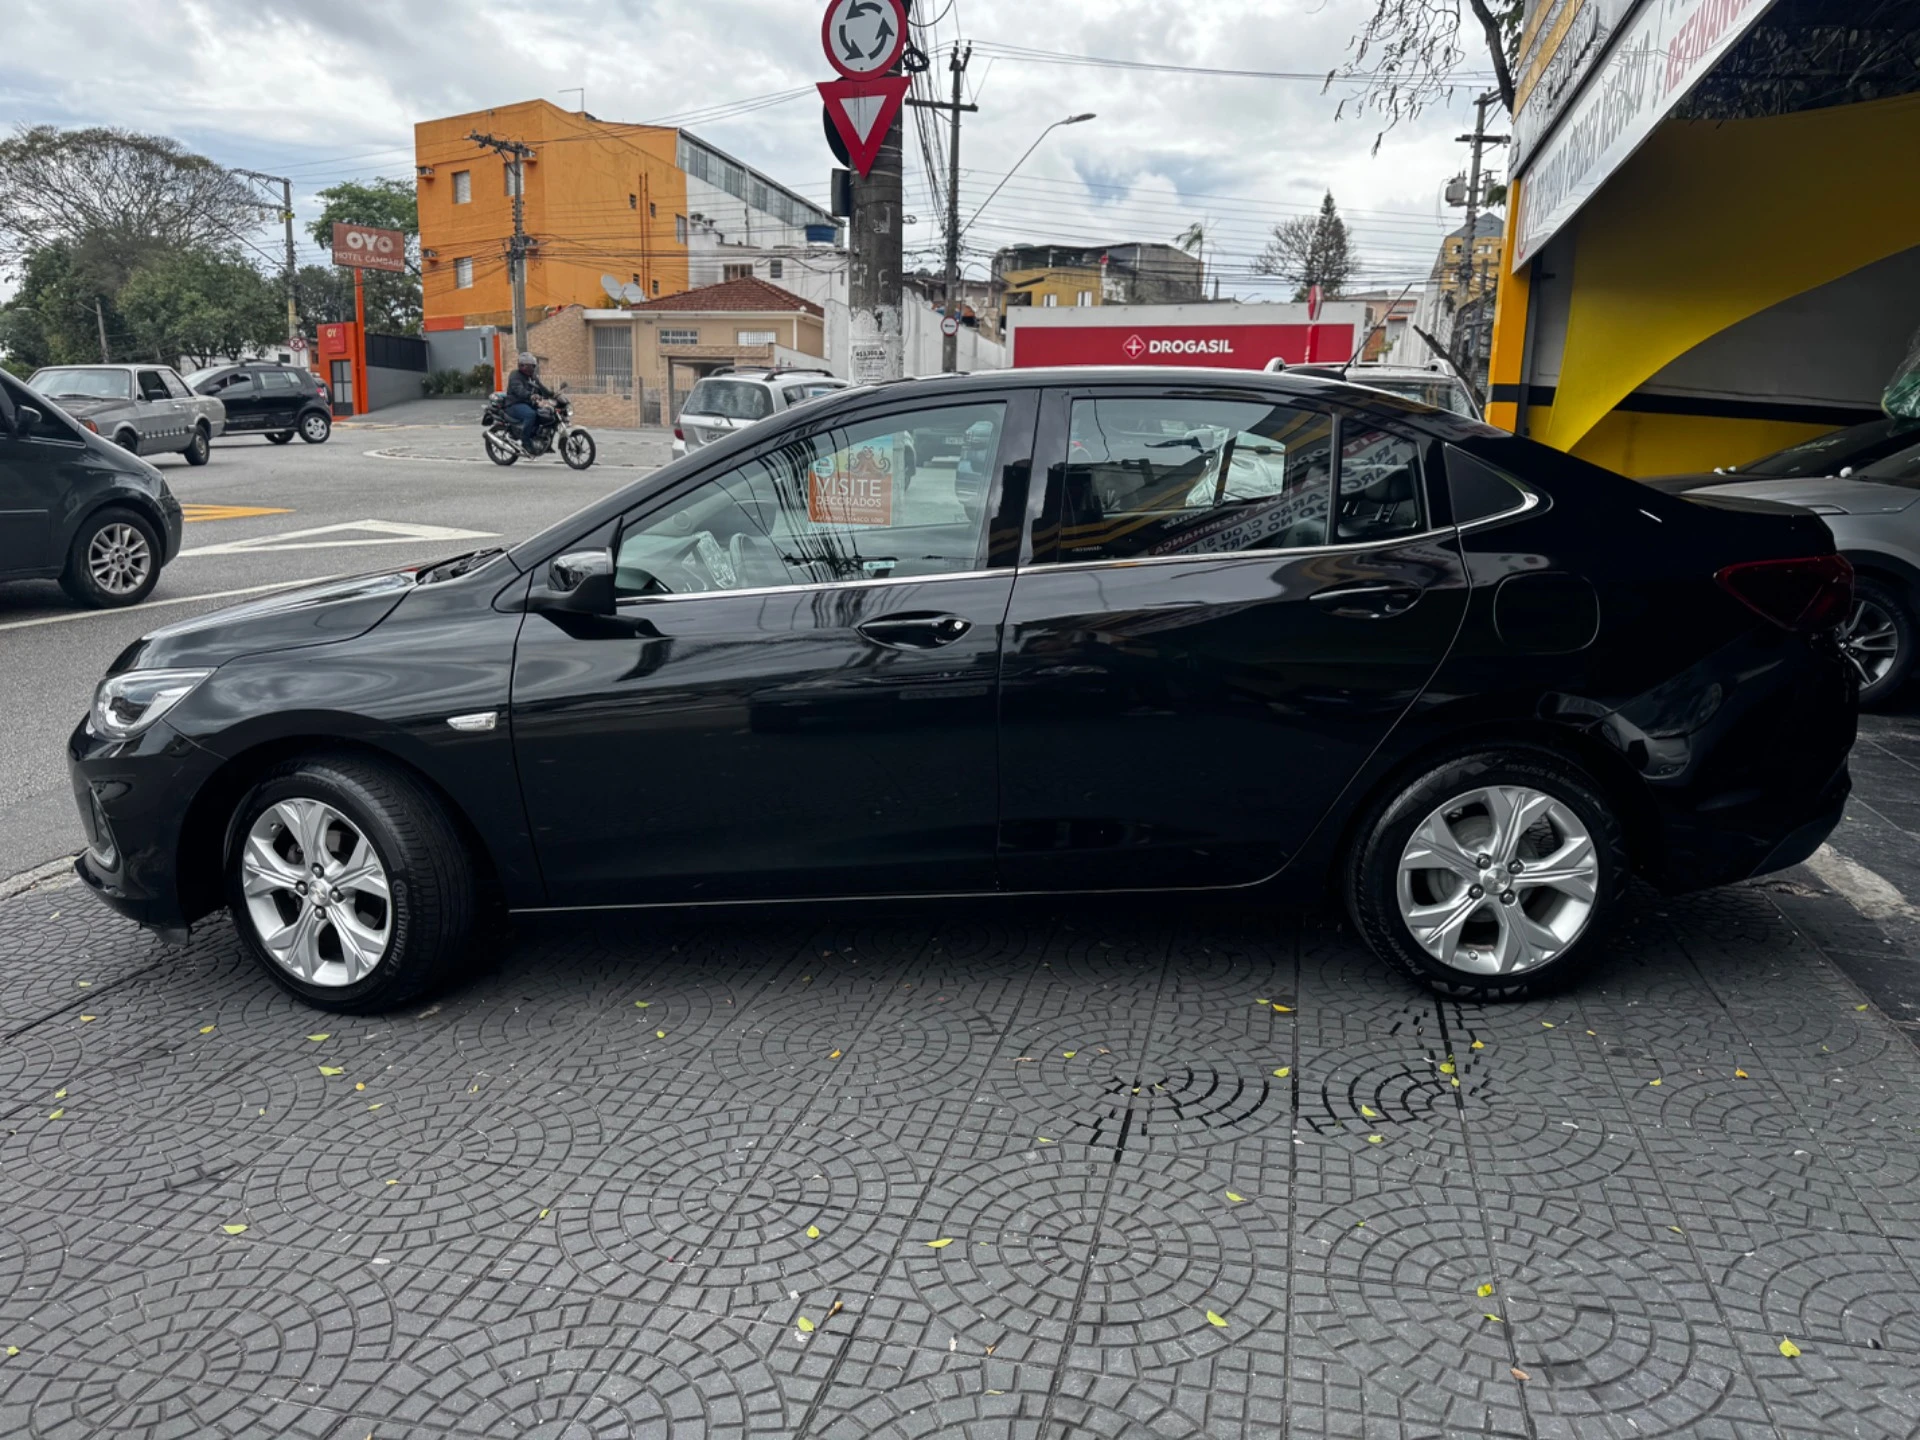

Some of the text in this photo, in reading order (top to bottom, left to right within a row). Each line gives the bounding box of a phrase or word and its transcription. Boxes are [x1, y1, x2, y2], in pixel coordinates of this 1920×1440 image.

[346, 231, 394, 254] OYO
[334, 251, 362, 262] HOTEL
[1148, 339, 1234, 353] DROGASIL
[816, 478, 881, 497] VISITE
[816, 495, 881, 508] DECORADOS
[389, 879, 411, 969] Continental
